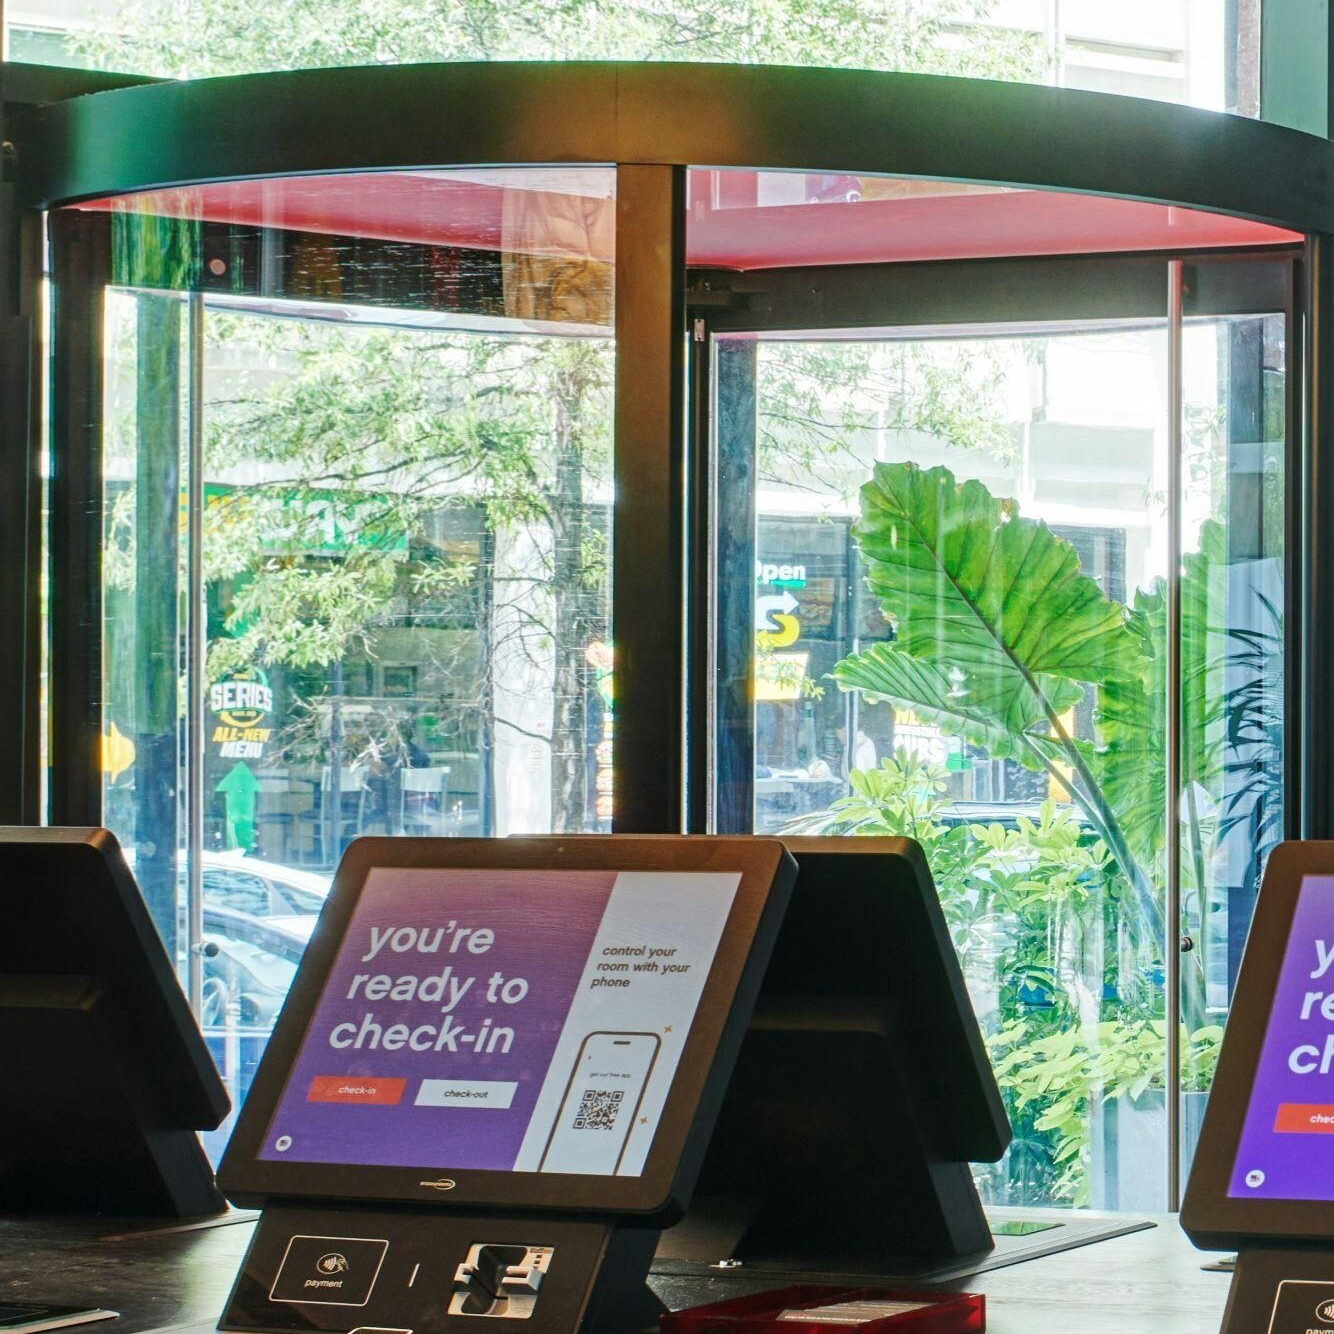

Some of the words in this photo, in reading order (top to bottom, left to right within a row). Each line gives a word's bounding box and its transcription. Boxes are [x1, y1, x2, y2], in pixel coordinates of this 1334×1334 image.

[210, 681, 273, 713] SERIES
[212, 726, 271, 743] ALL-NEW
[219, 740, 263, 758] MENU
[361, 920, 495, 962] you’re
[602, 946, 647, 956] control
[647, 947, 677, 959] your
[597, 962, 629, 971] room
[633, 961, 658, 972] with
[661, 964, 690, 975] your
[346, 966, 476, 1013] ready
[486, 972, 529, 1004] to
[590, 976, 631, 989] phone
[329, 1013, 515, 1053] check-in
[338, 1085, 377, 1095] check-in
[443, 1090, 489, 1099] check-out
[304, 1279, 343, 1289] payment
